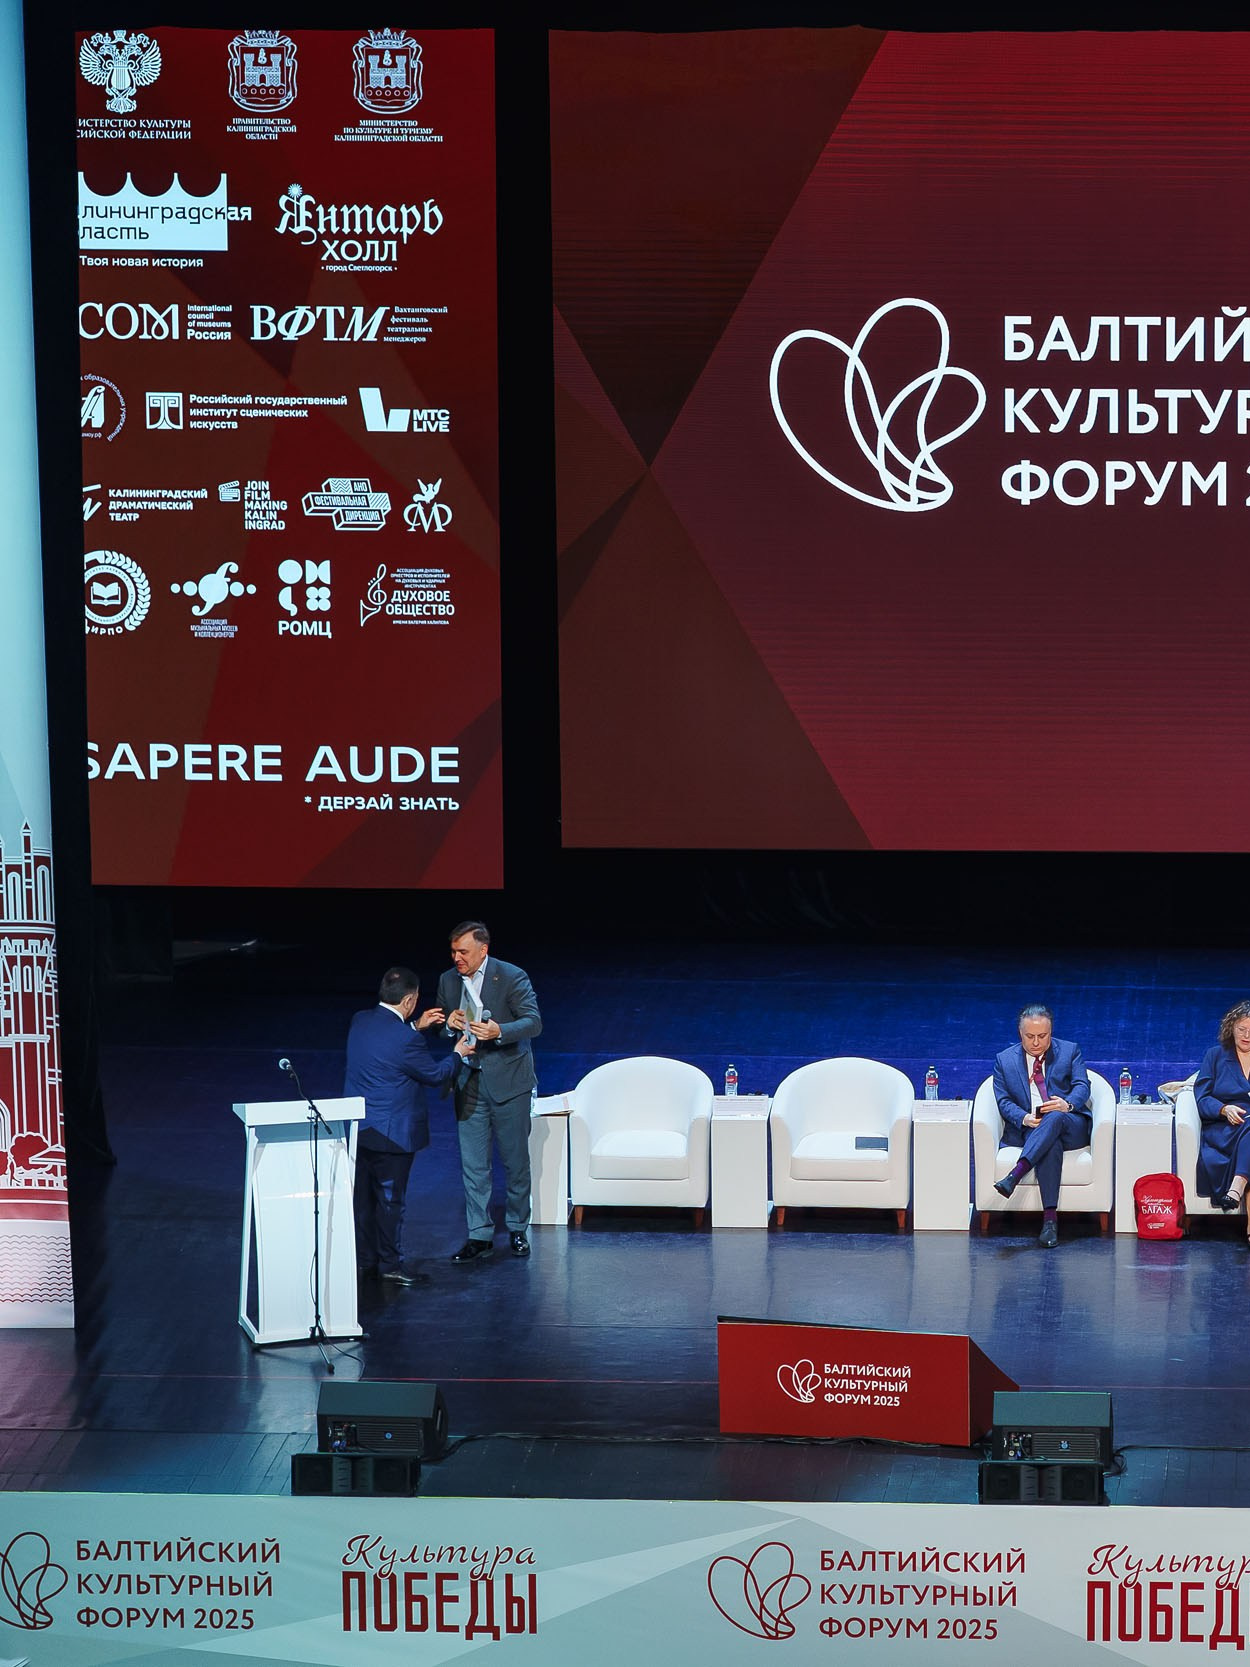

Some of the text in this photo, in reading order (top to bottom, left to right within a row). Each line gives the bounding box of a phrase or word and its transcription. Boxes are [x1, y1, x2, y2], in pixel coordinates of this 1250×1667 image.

[140, 119, 191, 129] КУЛЬТУРЫ
[233, 117, 291, 125] ПРАВИТЕЛЬСТВО
[359, 119, 418, 127] МИНИСТЕРСТВО
[227, 125, 297, 133] КАЛИНИНГРАДСКОЙ
[343, 127, 354, 135] ПО
[355, 127, 391, 135] КУЛЬТУРЕ
[400, 128, 434, 136] ТУРИЗМУ
[128, 130, 191, 140] ФЕДЕРАЦИИ
[334, 134, 408, 142] КАЛИНИНГРАДСКОЙ
[275, 193, 444, 246] Янтарь
[321, 239, 398, 261] ХОЛЛ
[79, 255, 204, 269] Твоя новая история
[325, 263, 393, 273] город Светлогорск
[394, 306, 448, 314] Вахтанговский
[187, 312, 214, 320] council
[390, 316, 429, 324] фестиваль
[187, 320, 196, 328] of
[250, 305, 390, 341] ВФТМ
[187, 328, 232, 341] Россия
[387, 325, 433, 333] театральных
[383, 335, 427, 344] менеджеров
[189, 393, 348, 406] Российский государственный
[189, 407, 308, 418] институт сценических
[413, 409, 450, 421] МТС
[189, 420, 238, 431] искусств
[413, 421, 450, 432] LIVE
[244, 480, 270, 491] JOIN
[353, 481, 368, 492] АНО
[1001, 459, 1227, 506] ФОРУМ
[108, 488, 208, 499] КАЛИНИНГРАДСКИЙ
[244, 491, 271, 500] FILM
[108, 500, 193, 511] ДРАМАТИЧЕСКИЙ
[244, 501, 288, 511] MAKING
[314, 495, 368, 506] ФЕСТИВАЛЬНАЯ
[109, 512, 140, 522] ТЕАТР
[244, 511, 278, 521] KALIN
[345, 510, 381, 522] ДИРЕКЦИЯ
[244, 521, 286, 531] INGRAD
[390, 590, 451, 603] ДУХОВОЕ
[385, 603, 455, 617] ОБЩЕСТВО
[91, 625, 124, 635] ИРПО
[278, 620, 332, 639] РОМЦ
[87, 741, 460, 784] SAPERE AUDE
[317, 794, 460, 812] ДЕРЗАЙ ЗНАТЬ
[1141, 1205, 1173, 1215] БАГАЖ
[824, 1363, 911, 1379] БАЛТИЙСКИЙ
[824, 1378, 908, 1393] КУЛЬТУРНЫЙ
[824, 1393, 900, 1407] ФОРУМ 2025
[76, 1538, 281, 1565] БАЛТИЙСКИЙ
[342, 1533, 537, 1580] Культура
[820, 1546, 1026, 1574] БАЛТИЙСКИЙ
[76, 1571, 273, 1598] КУЛЬТУРНЫЙ
[819, 1581, 1018, 1608] КУЛЬТУРНЫЙ
[342, 1571, 538, 1640] ПОБЕДЫ
[76, 1606, 255, 1630] ФОРУМ 2025
[818, 1616, 998, 1641] ФОРУМ 2025
